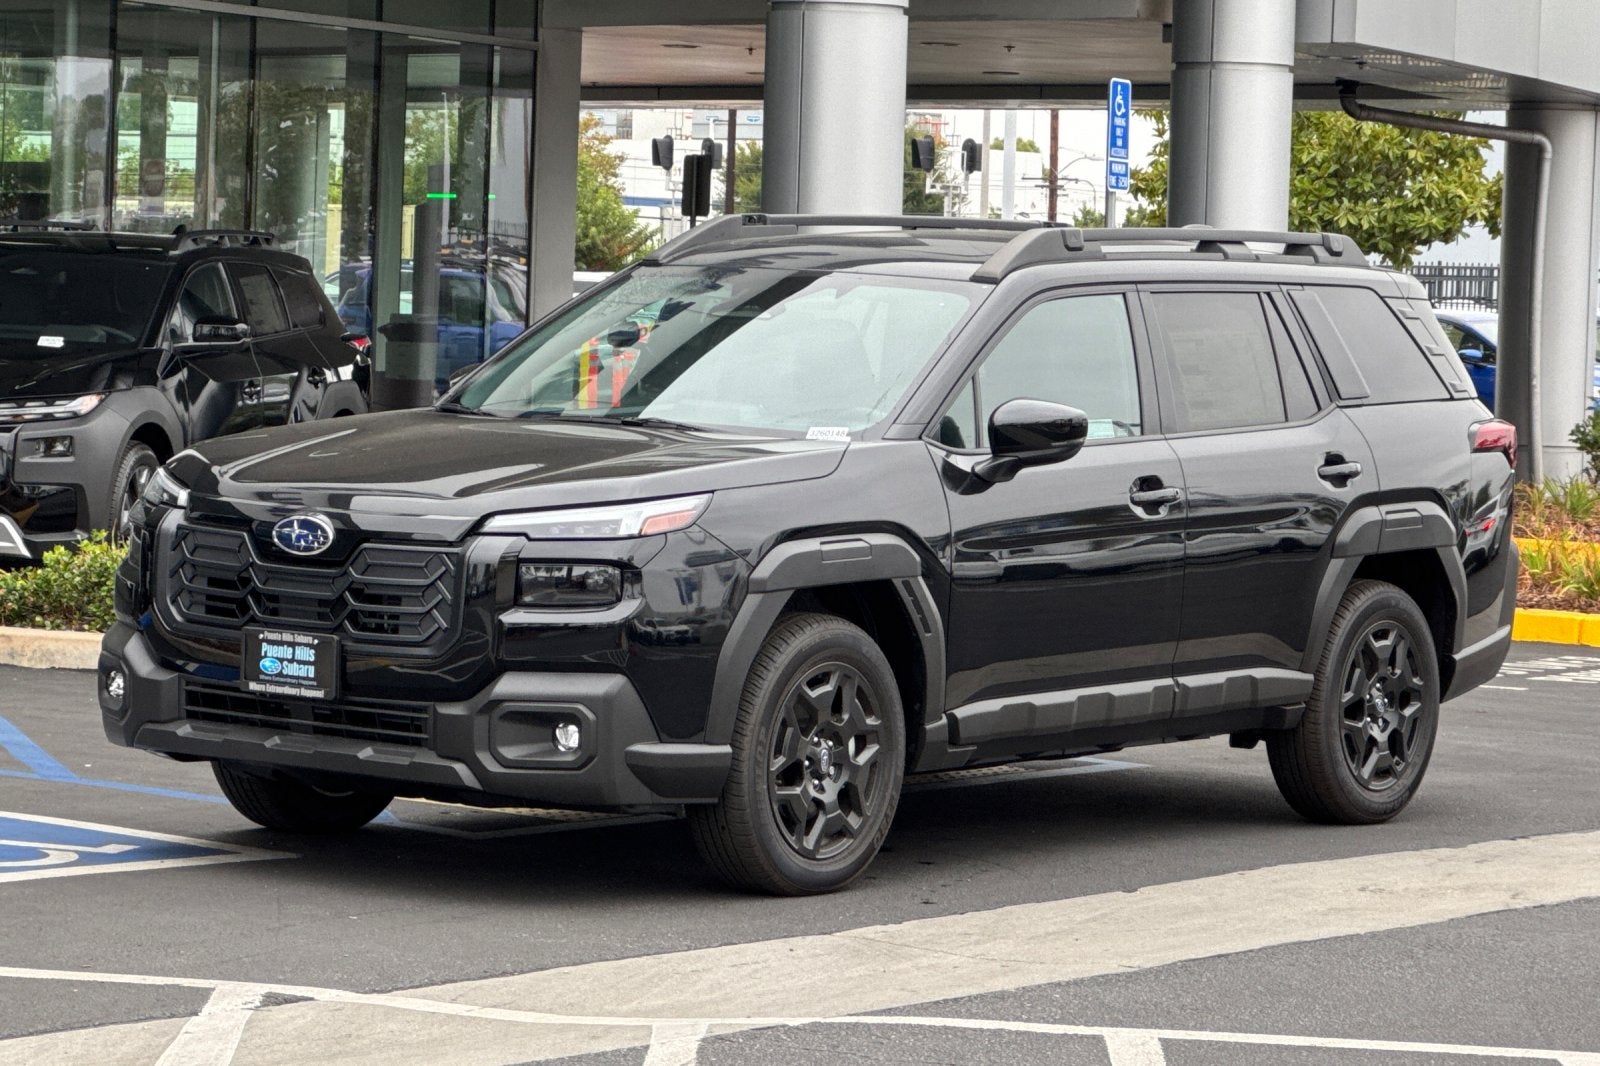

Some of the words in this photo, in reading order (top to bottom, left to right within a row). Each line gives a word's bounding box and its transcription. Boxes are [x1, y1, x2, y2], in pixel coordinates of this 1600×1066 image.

[295, 634, 313, 644] Subaru
[262, 642, 293, 659] Puente
[295, 646, 315, 661] Hills
[282, 661, 315, 678] Subaru
